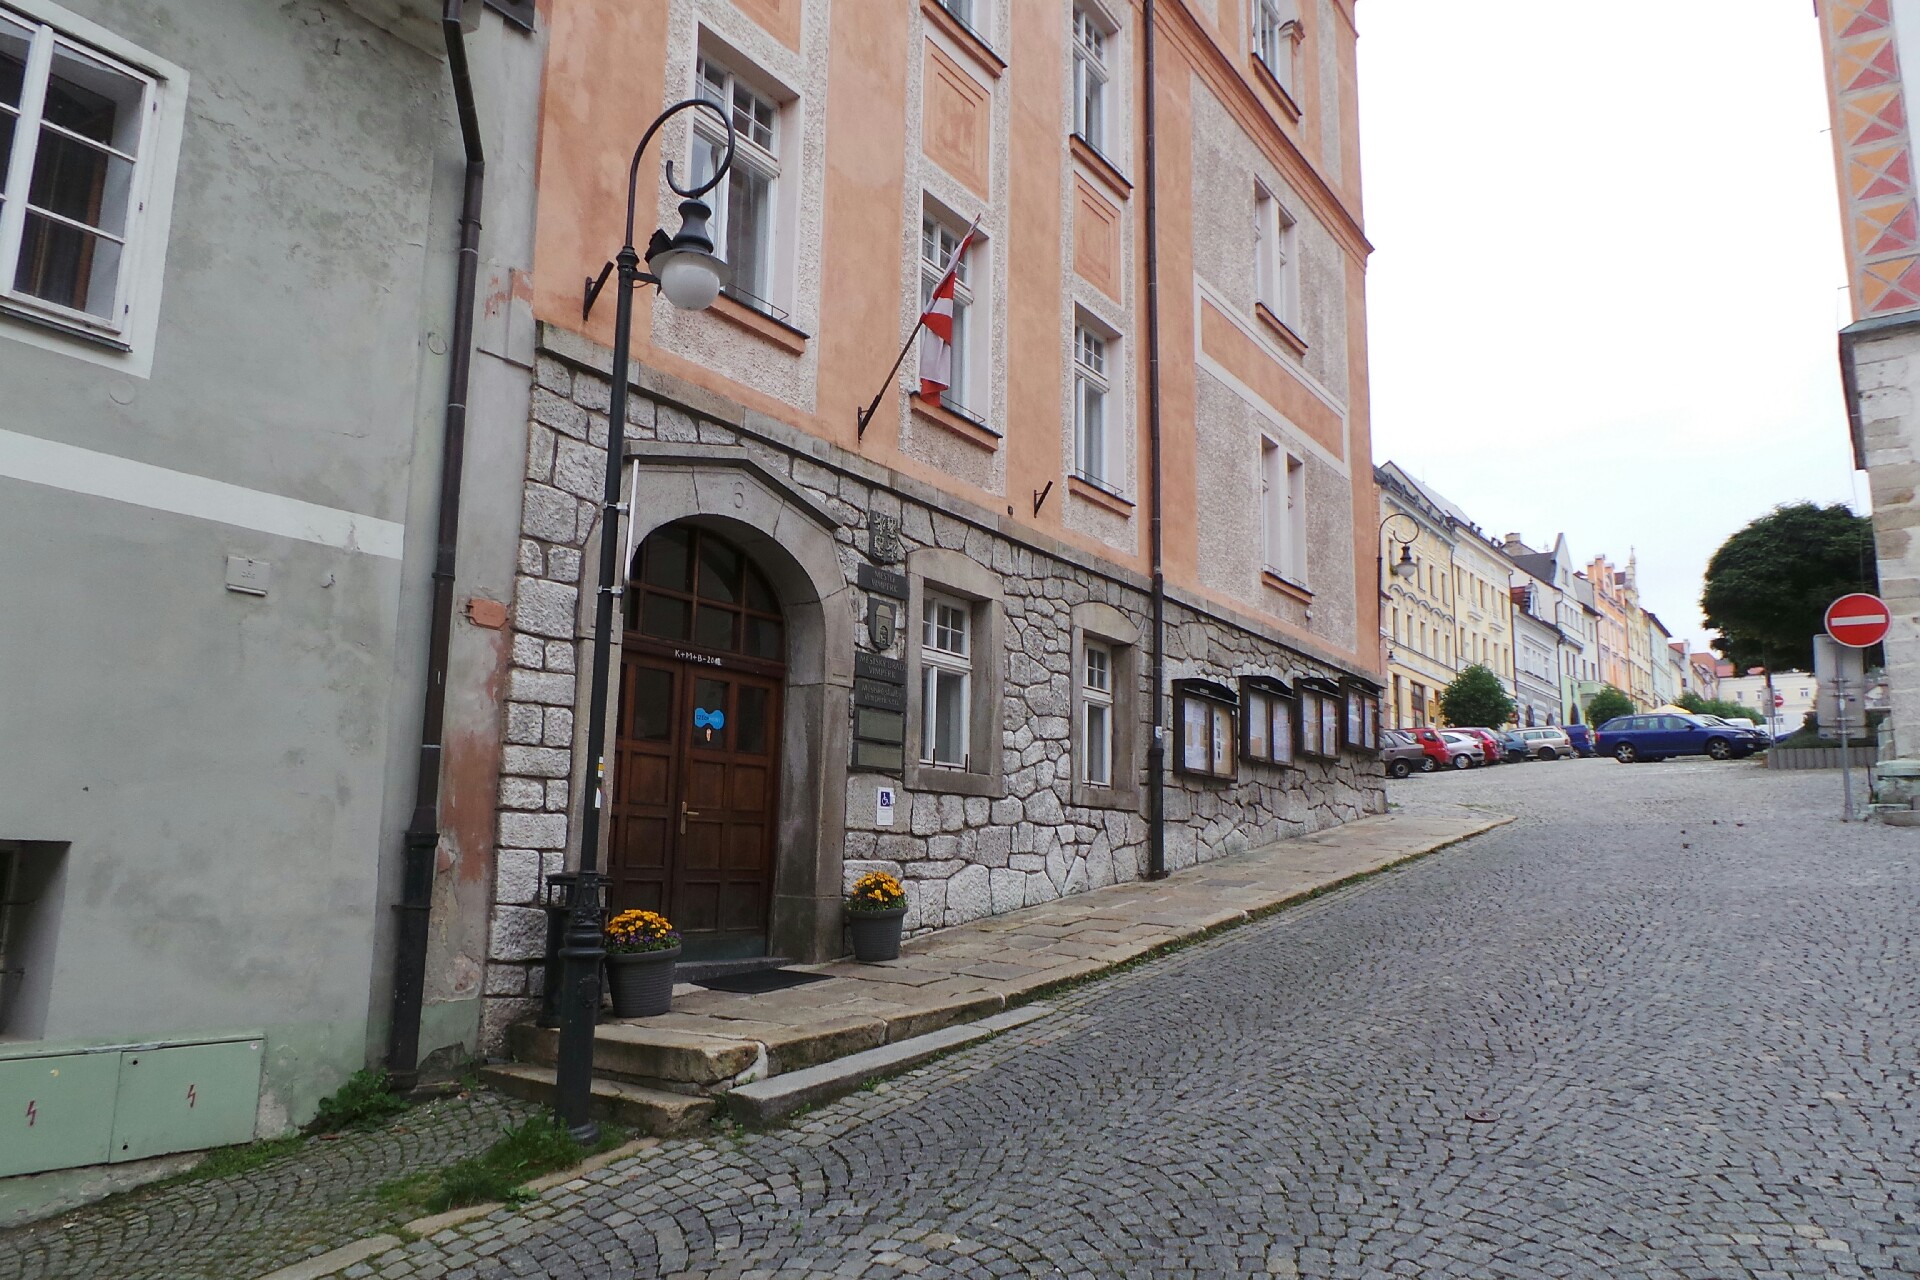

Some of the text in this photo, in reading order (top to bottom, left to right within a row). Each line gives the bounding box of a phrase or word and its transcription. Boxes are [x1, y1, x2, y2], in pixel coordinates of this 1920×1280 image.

[874, 570, 895, 583] MĚSTO
[871, 578, 898, 593] VIMPERK
[868, 665, 896, 678] VIMPERK
